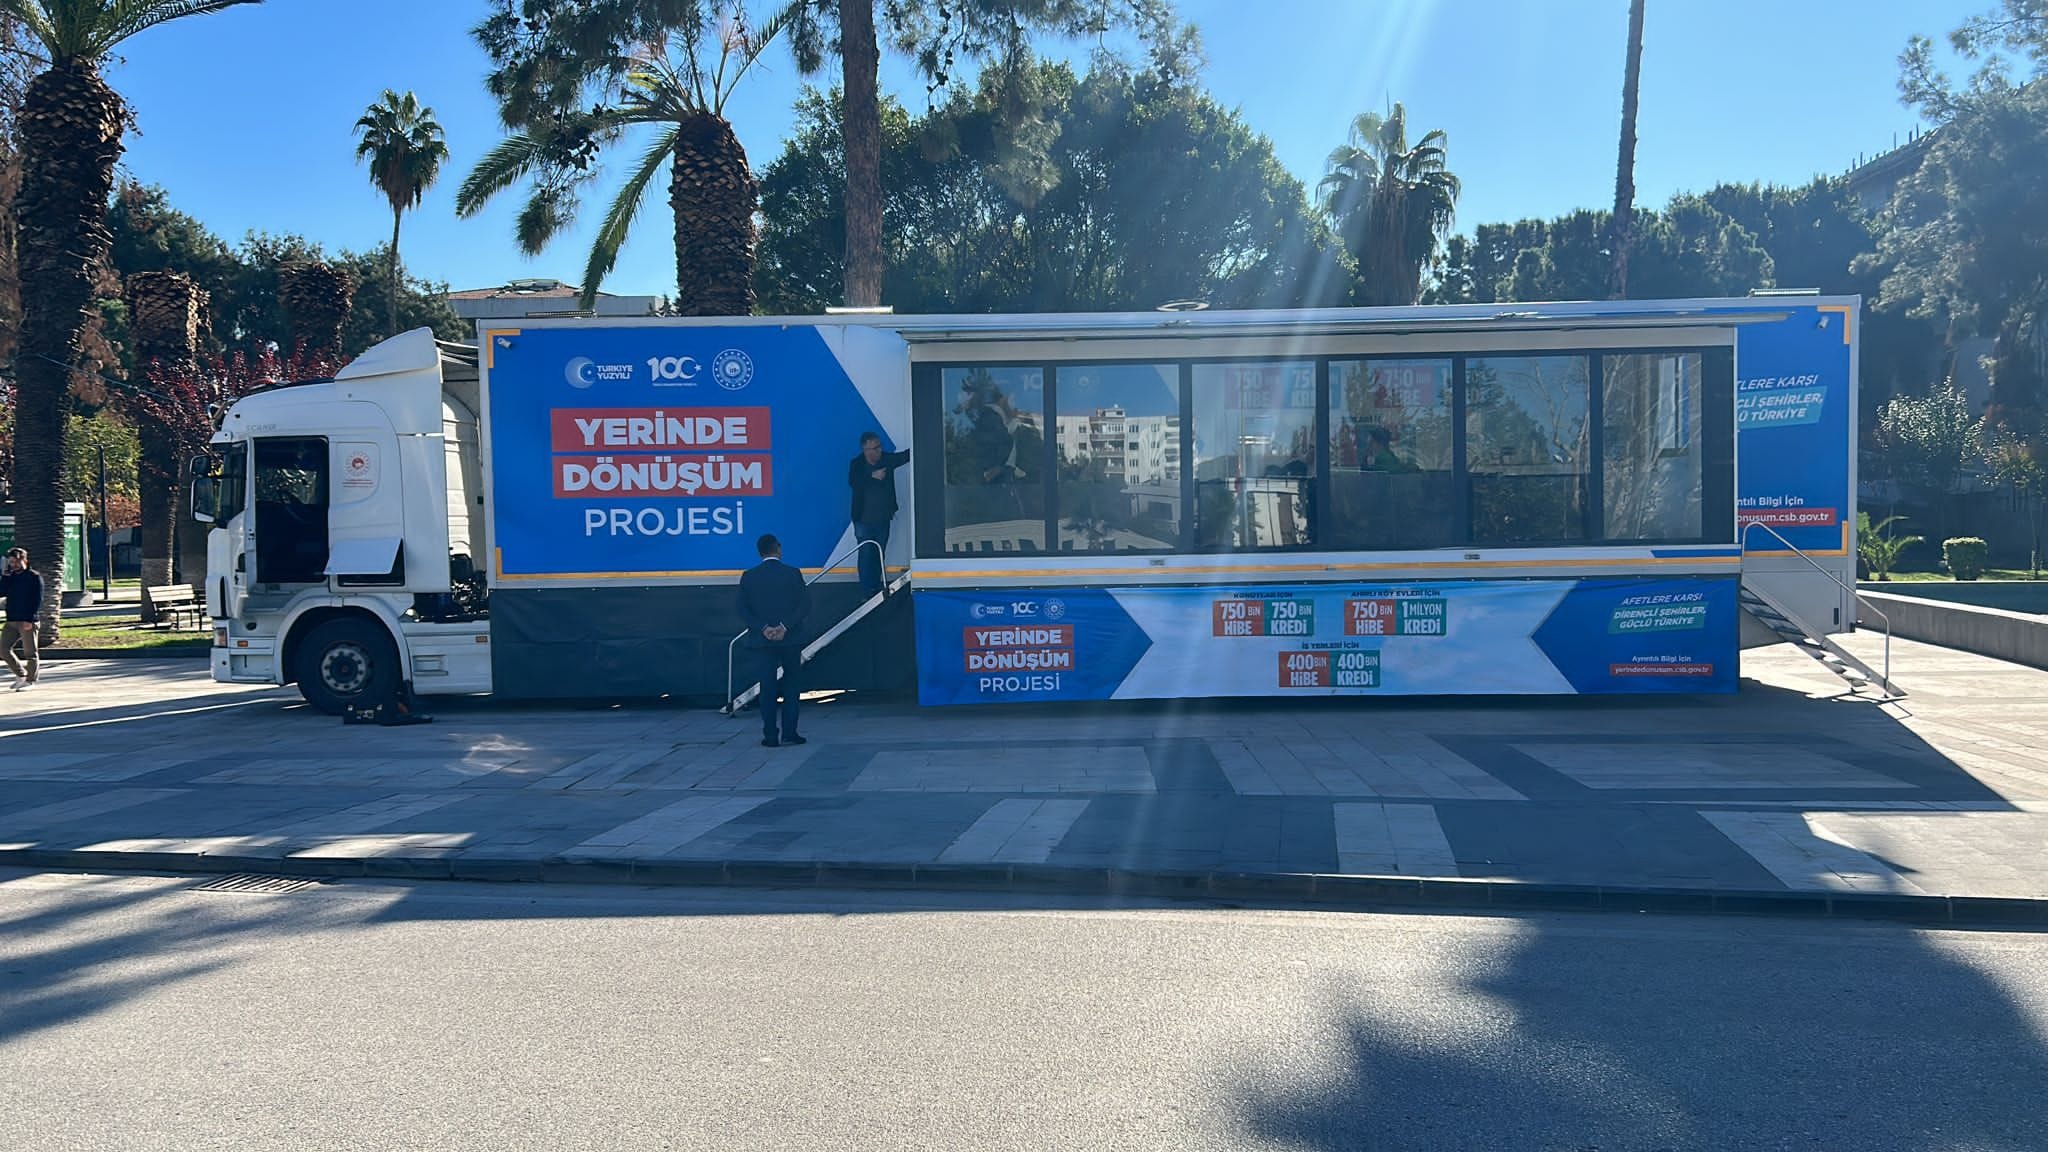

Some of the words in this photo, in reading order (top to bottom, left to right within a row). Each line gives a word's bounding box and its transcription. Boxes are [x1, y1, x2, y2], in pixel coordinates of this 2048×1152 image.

[575, 411, 748, 446] YERİNDE
[563, 456, 762, 496] DÖNÜŞÜM
[1759, 496, 1782, 507] Bilgi
[1785, 495, 1804, 507] İçin
[585, 501, 744, 536] PROJESİ
[1621, 595, 1672, 606] AFETLERE
[1220, 602, 1246, 619] 750
[1271, 601, 1297, 618] 750
[1352, 601, 1378, 618] 750
[1402, 601, 1409, 618] 1
[1409, 602, 1442, 616] MİLYON
[975, 627, 1063, 646] YERİNDE
[969, 650, 1070, 670] DÖNÜŞÜM
[1287, 654, 1313, 670] 400
[1337, 653, 1364, 669] 400
[980, 672, 1061, 692] PROJESİ
